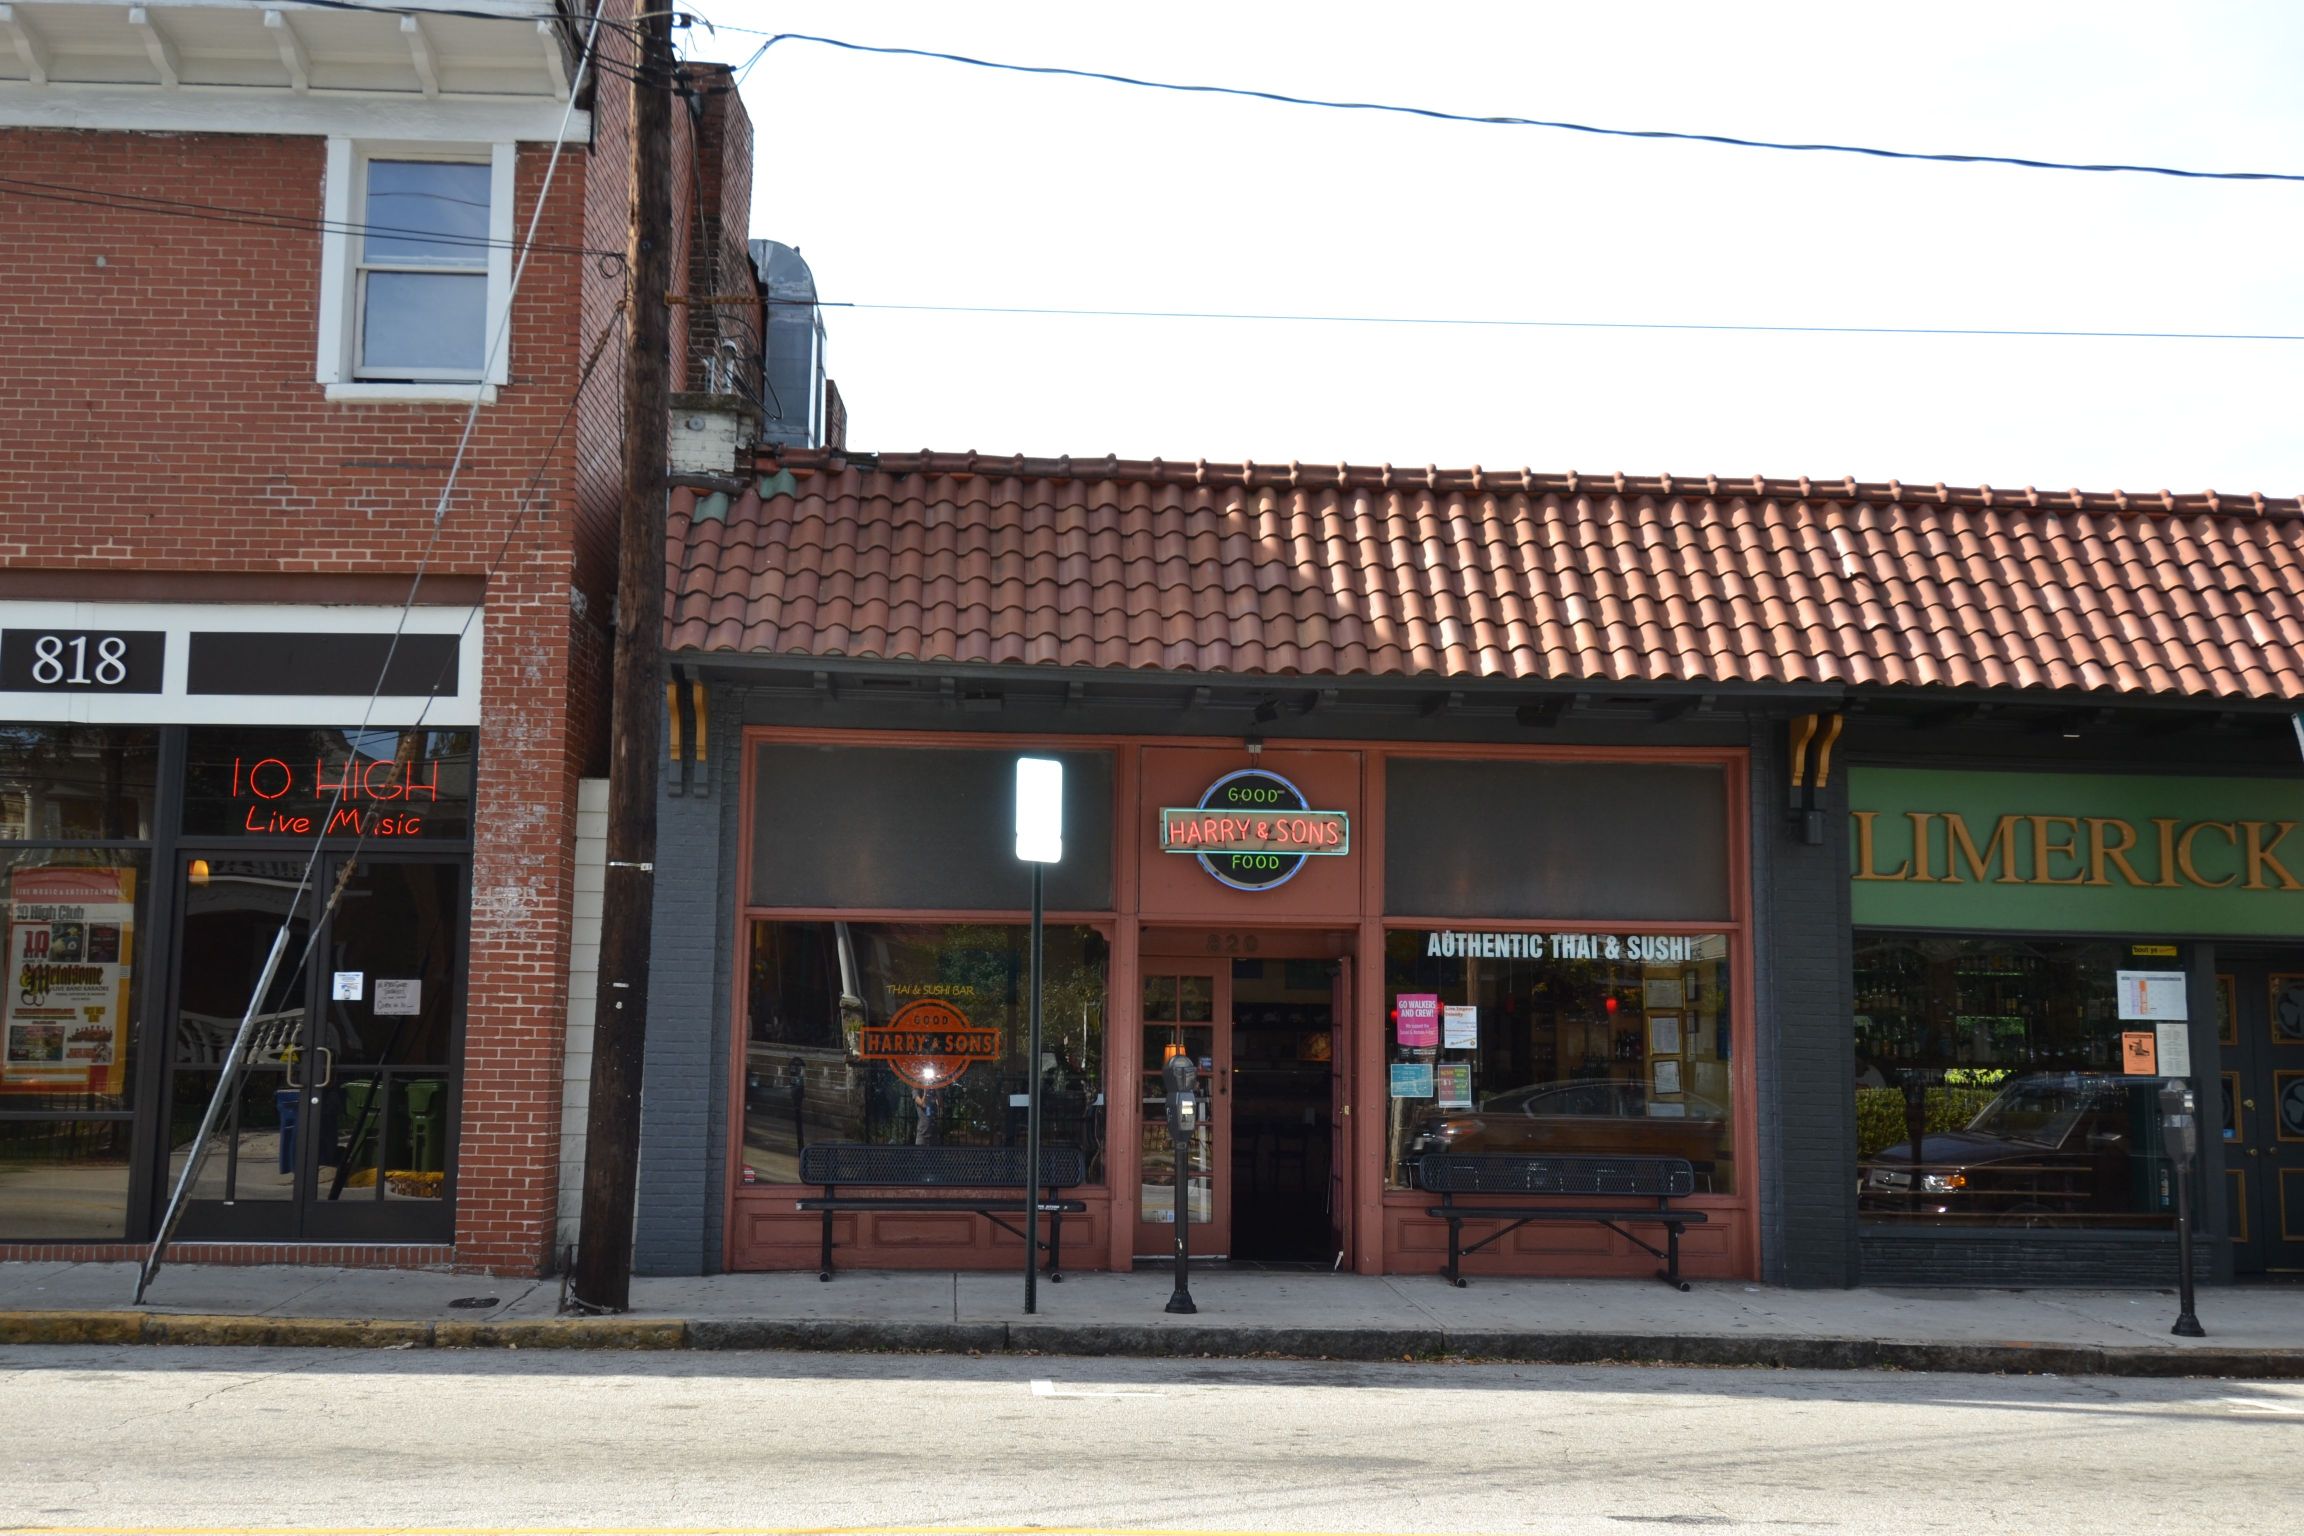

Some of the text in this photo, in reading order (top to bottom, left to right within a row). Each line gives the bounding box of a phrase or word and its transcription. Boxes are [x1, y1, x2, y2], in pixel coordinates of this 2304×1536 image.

[32, 635, 127, 685] 818
[316, 758, 438, 802] HIGH
[1228, 787, 1278, 803] GOOD
[245, 805, 311, 834] Live
[1170, 817, 1339, 845] HARRY & SONS
[1851, 811, 2304, 890] LIMERICK
[1232, 855, 1280, 870] FOOD
[33, 888, 57, 896] MUSIC
[16, 905, 85, 922] 10 High Club
[1206, 934, 1258, 953] 820
[1427, 932, 1692, 961] AUTHENTIC THAI & SUSHI
[886, 984, 975, 995] THAI & SUSHI BAR
[1398, 1000, 1436, 1009] GO WALKERS
[1401, 1009, 1434, 1018] AND CREW!
[914, 1015, 949, 1025] GOOD
[868, 1034, 993, 1053] HARRY & SONS
